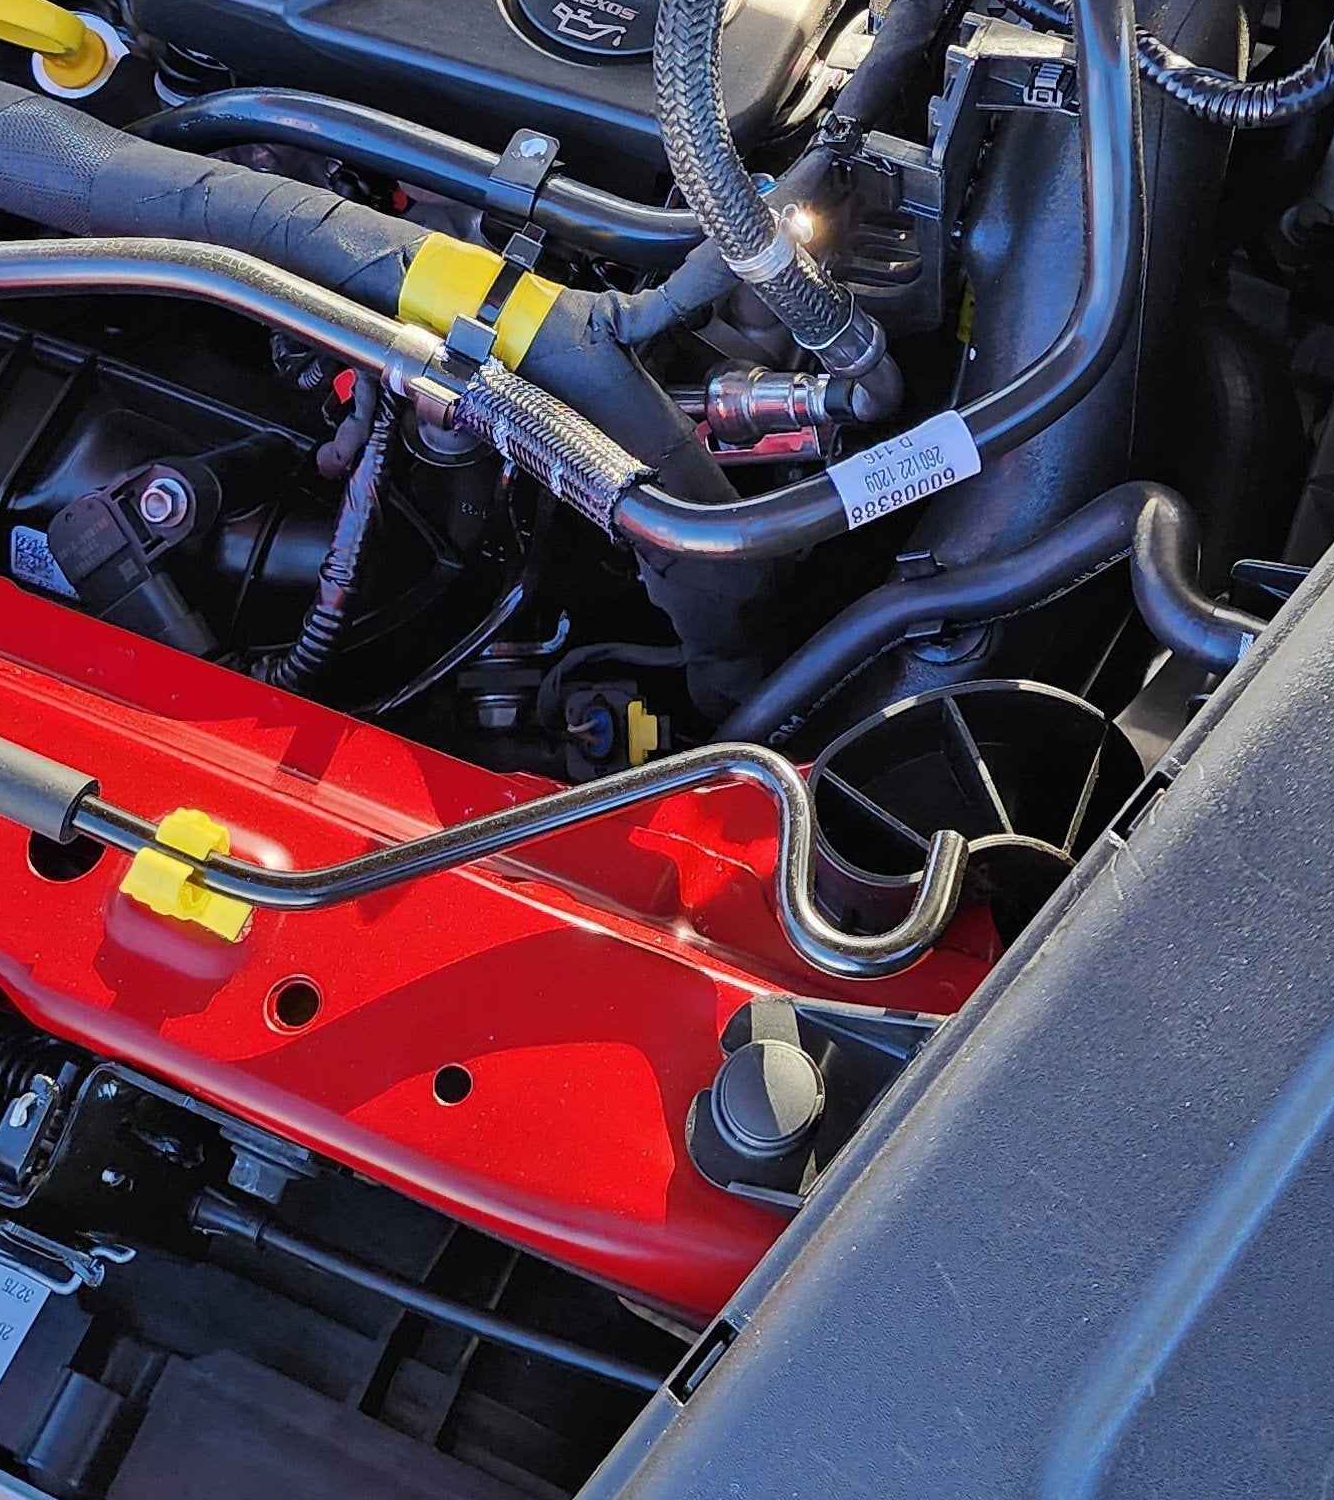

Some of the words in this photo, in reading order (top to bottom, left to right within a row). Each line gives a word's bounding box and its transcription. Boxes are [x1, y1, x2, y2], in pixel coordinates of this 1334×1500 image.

[896, 445, 946, 481] 260122
[851, 466, 956, 524] 60008388
[864, 466, 897, 494] 1209
[1, 1276, 36, 1304] 3275
